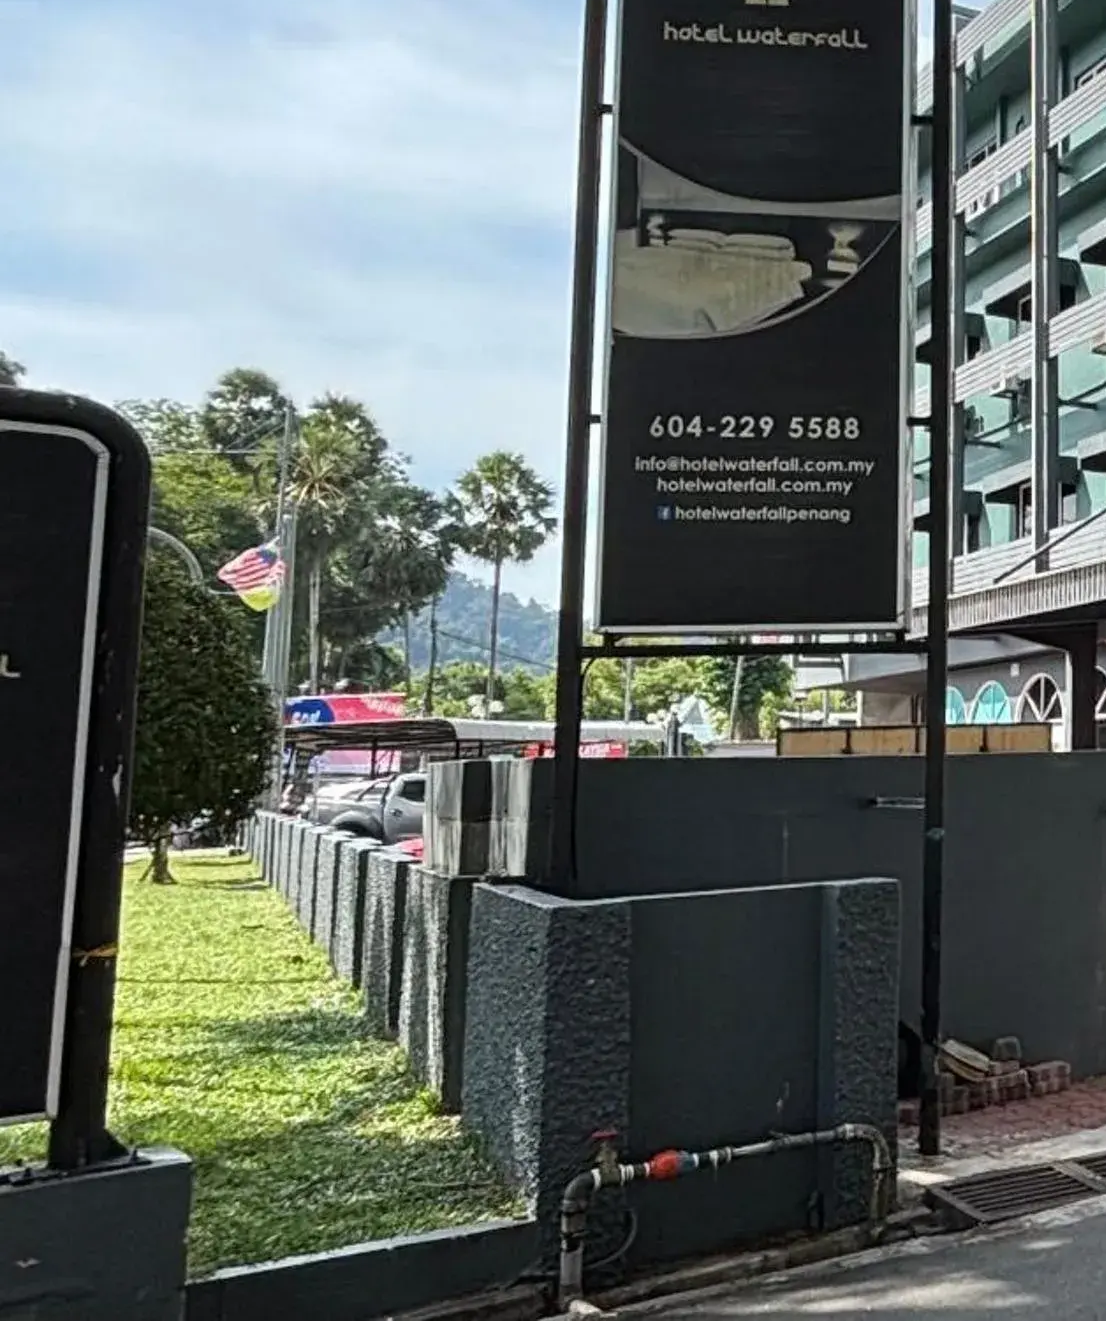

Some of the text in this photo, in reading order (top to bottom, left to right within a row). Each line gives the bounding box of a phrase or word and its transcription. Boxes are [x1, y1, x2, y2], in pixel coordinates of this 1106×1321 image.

[649, 415, 860, 440] 604-229 5588
[635, 455, 874, 476] info@hotelwaterfall.com.my
[656, 477, 853, 496] hotelwaterfall.com.my
[675, 506, 851, 523] hotelwaterfallpenang
